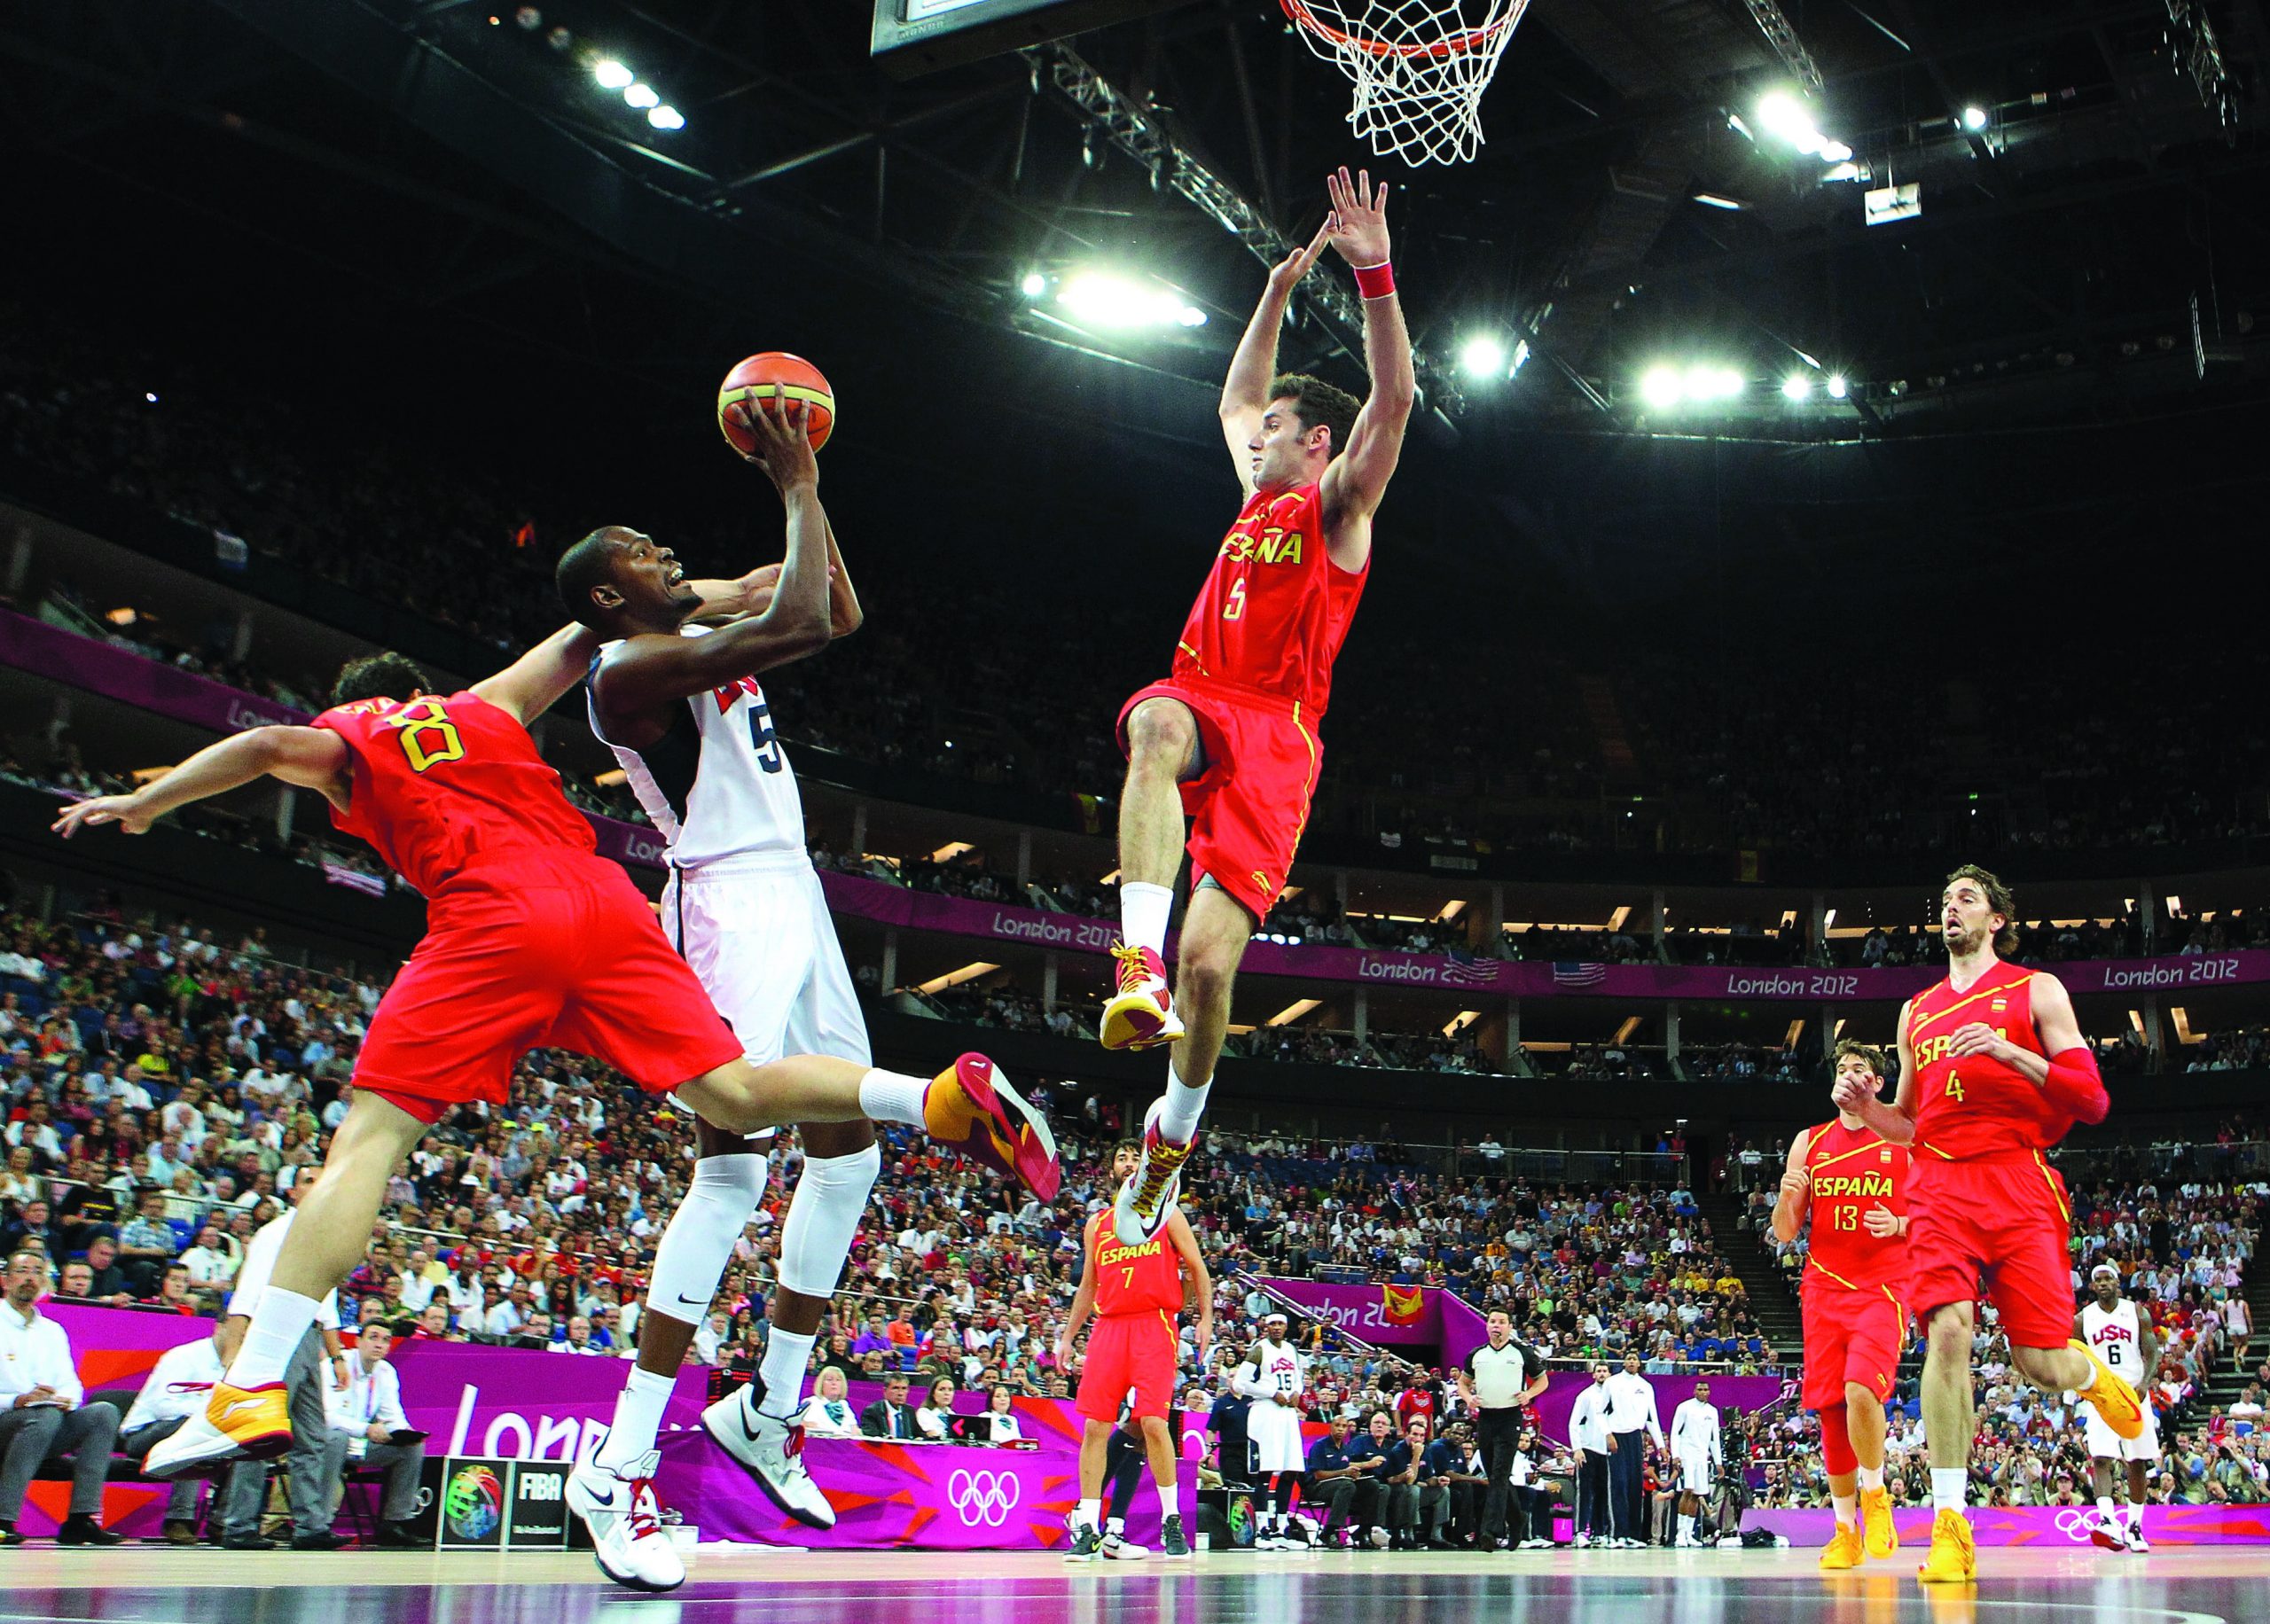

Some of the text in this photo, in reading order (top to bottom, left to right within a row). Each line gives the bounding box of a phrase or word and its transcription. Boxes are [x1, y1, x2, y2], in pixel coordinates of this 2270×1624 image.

[1223, 577, 1246, 619] 5
[383, 701, 466, 773] 8
[748, 704, 782, 773] 5
[993, 911, 1072, 942] London
[1359, 956, 1436, 981] London
[2104, 957, 2239, 987] London 2012
[1727, 973, 1858, 995] London 2012
[1945, 1069, 1965, 1102] 4
[1814, 1170, 1893, 1198] ESPAÑA
[1834, 1205, 1858, 1231] 13
[1121, 1267, 1134, 1289] 7
[2093, 1323, 2132, 1346] USA
[2108, 1344, 2121, 1365] 6
[1276, 1373, 1292, 1391] 15
[519, 1472, 562, 1501] FIBA
